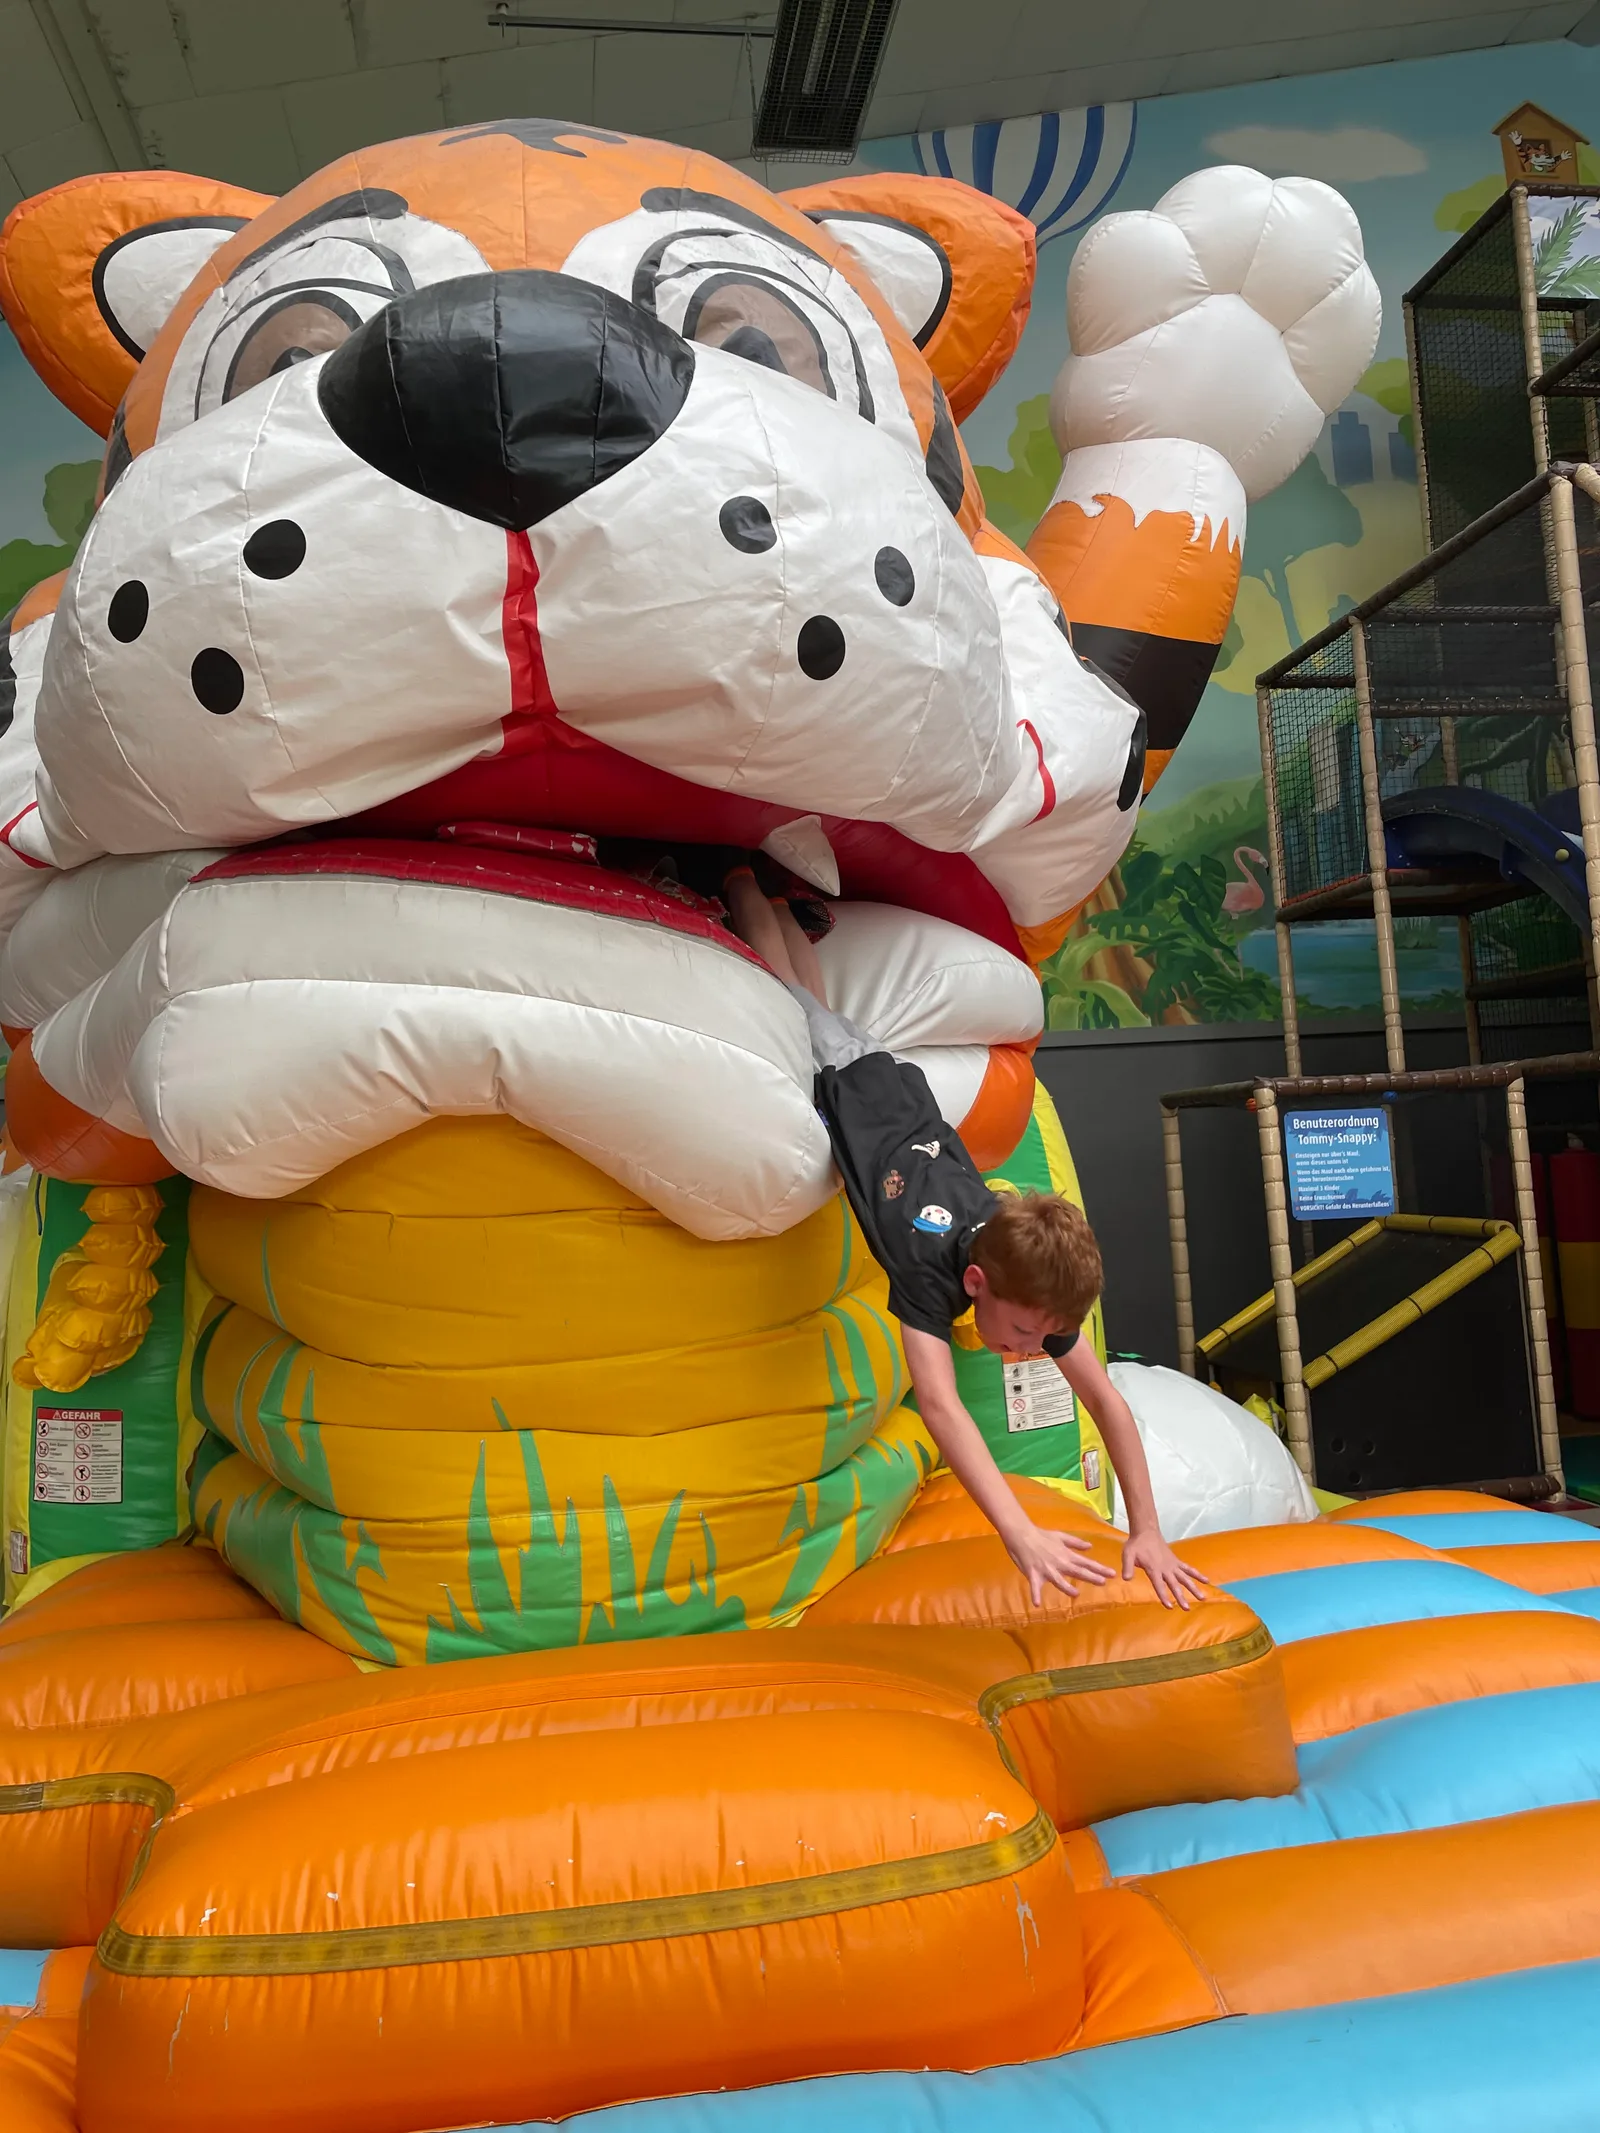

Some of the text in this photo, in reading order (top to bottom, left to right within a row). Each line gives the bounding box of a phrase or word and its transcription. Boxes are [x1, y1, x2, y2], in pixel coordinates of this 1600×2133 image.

[1293, 1115, 1379, 1129] Benutzerordnung
[1298, 1133, 1377, 1146] Tommy-Snappy:
[61, 1411, 101, 1420] GEFAHR
